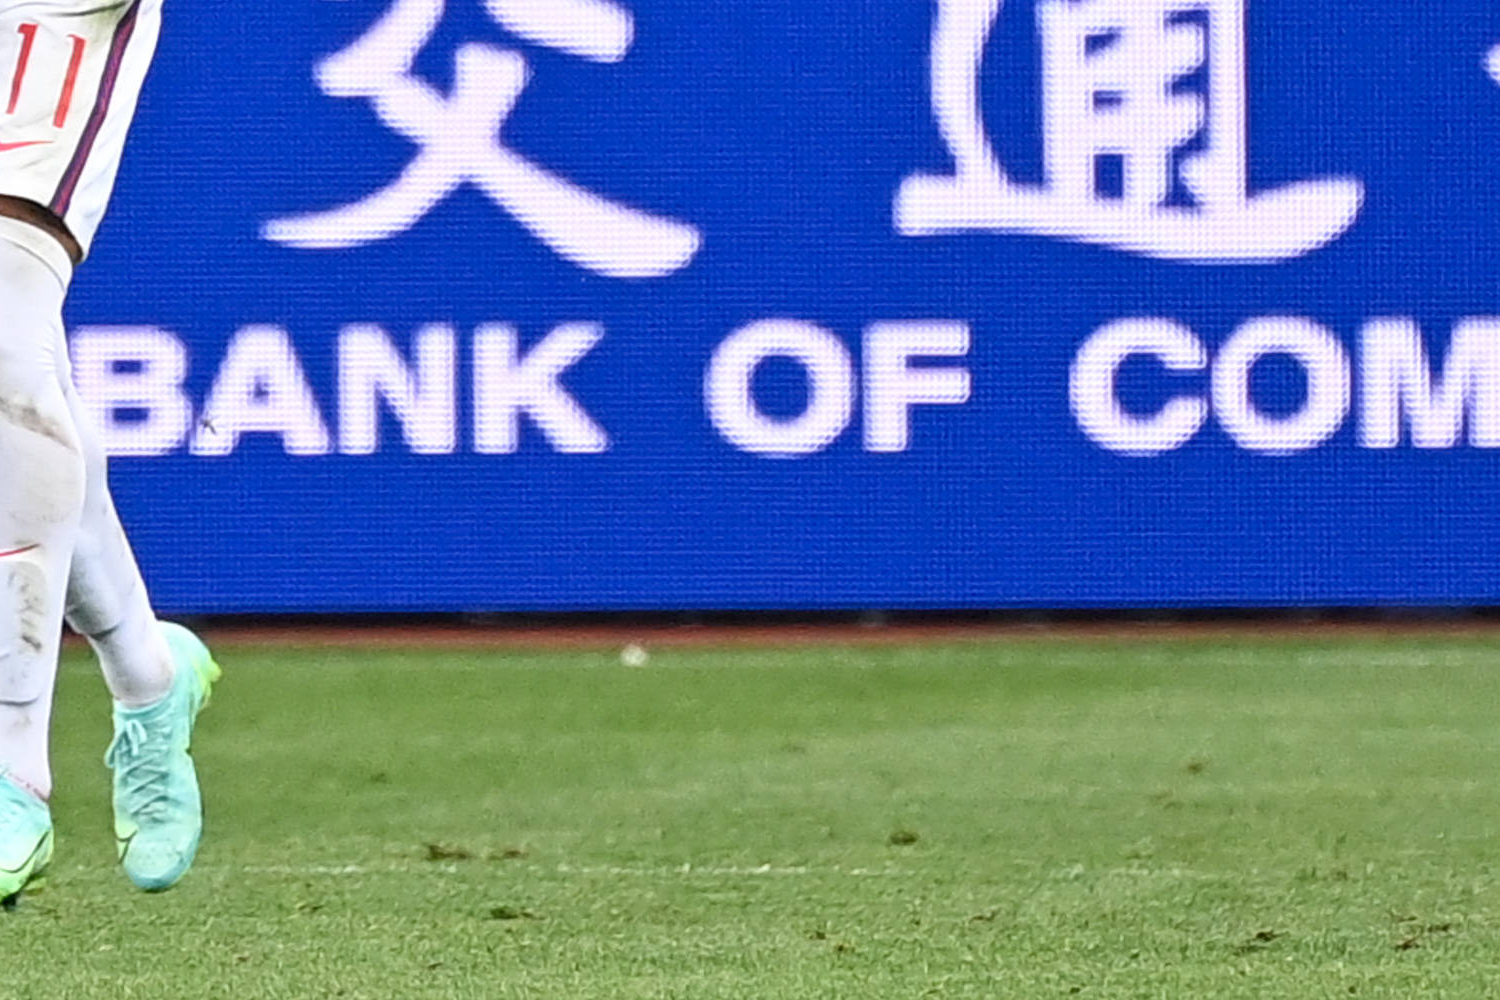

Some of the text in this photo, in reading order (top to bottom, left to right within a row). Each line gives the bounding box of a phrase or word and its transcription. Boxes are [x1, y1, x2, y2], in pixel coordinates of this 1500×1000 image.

[5, 23, 87, 129] 11
[69, 314, 1500, 458] BANK OF COM
